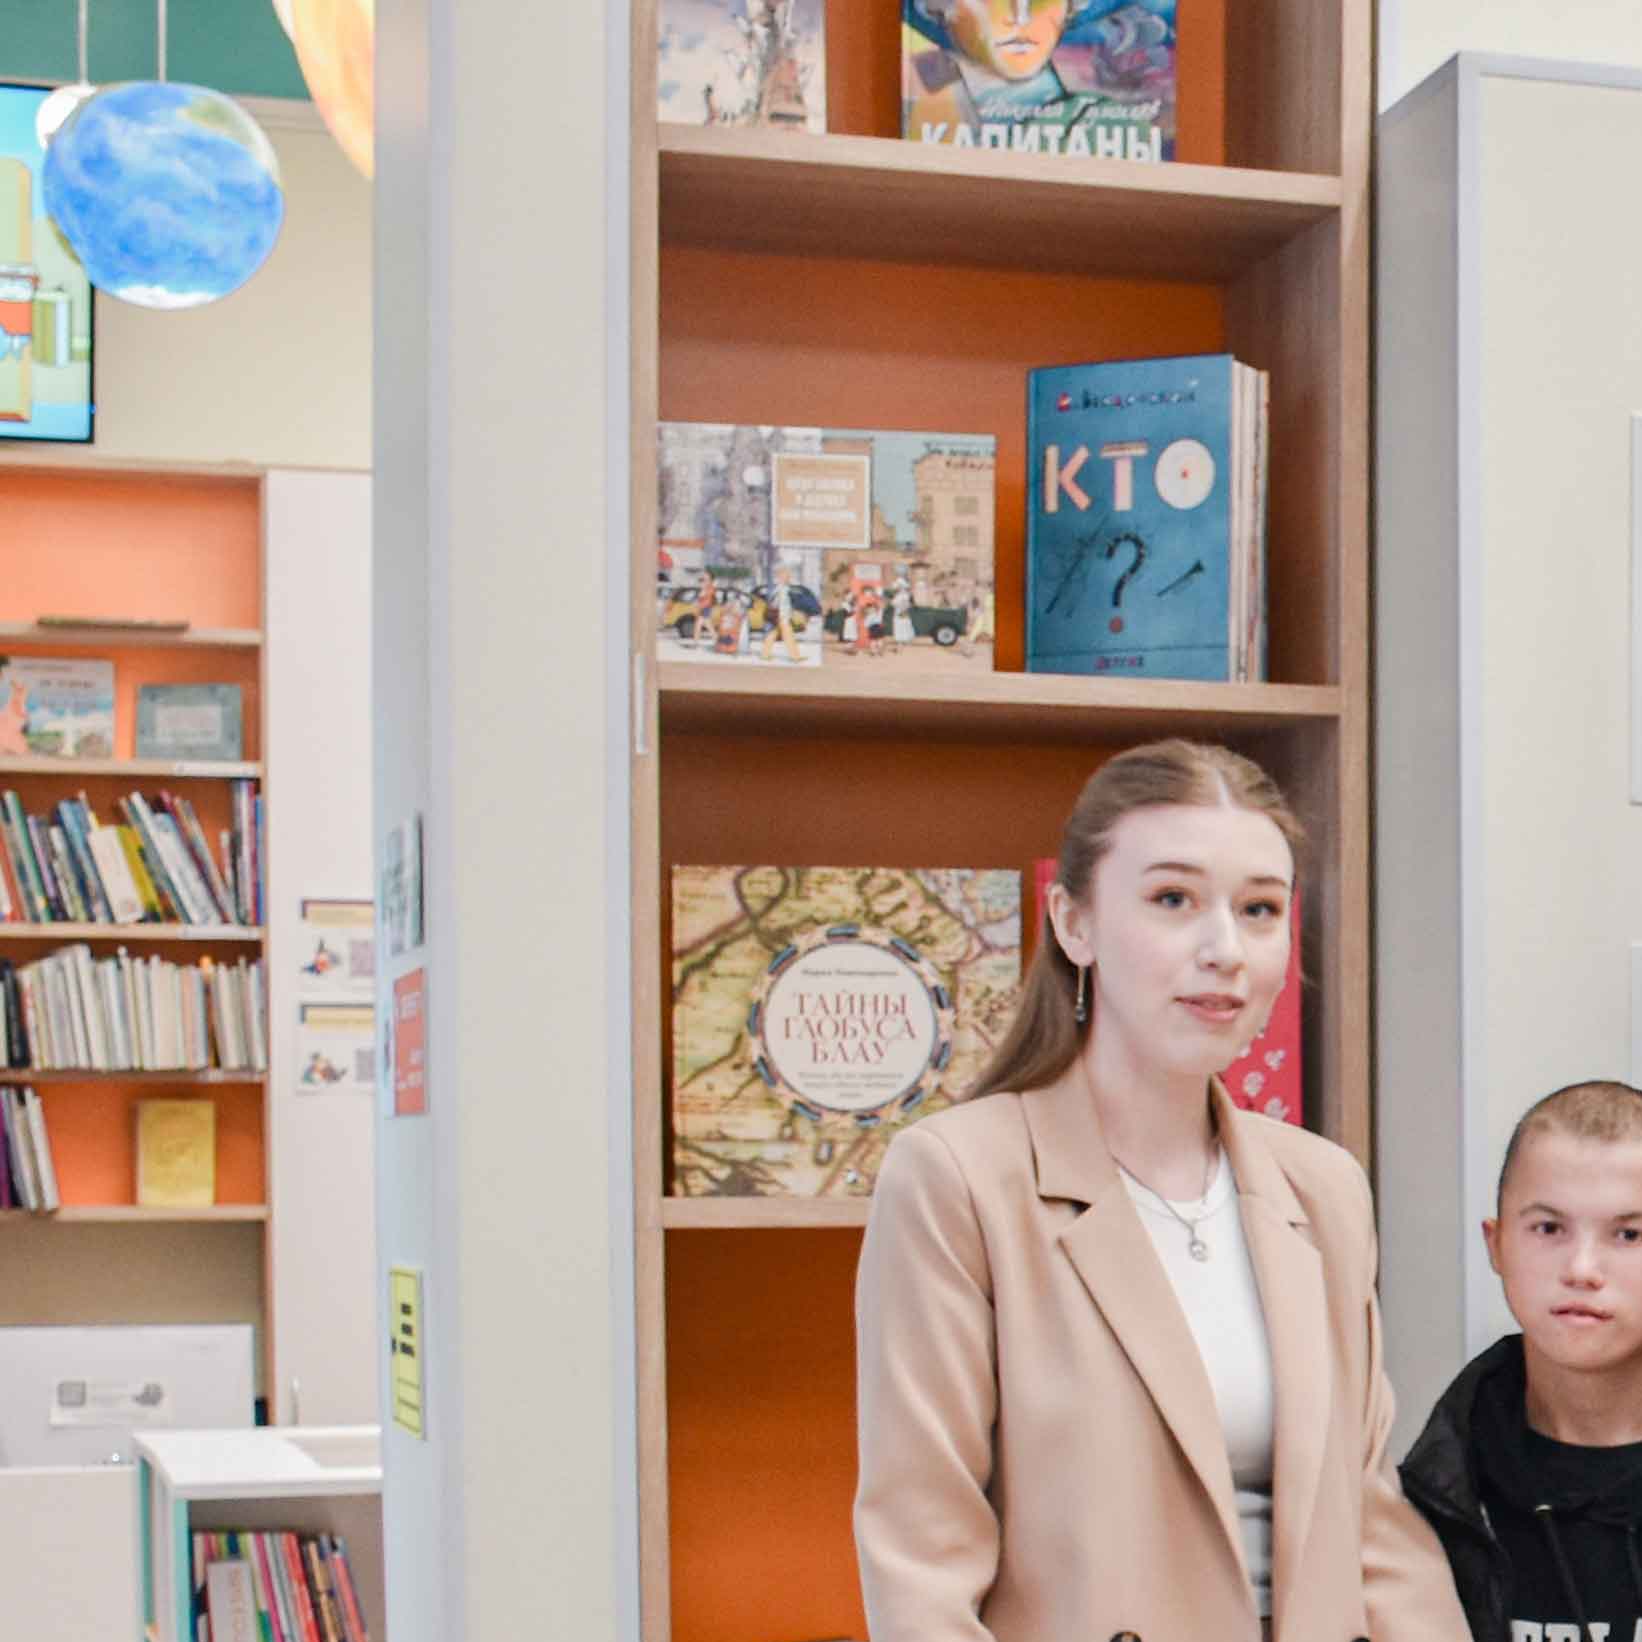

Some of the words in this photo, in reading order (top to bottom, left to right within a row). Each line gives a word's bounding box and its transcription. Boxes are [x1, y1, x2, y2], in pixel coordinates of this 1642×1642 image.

[921, 121, 1162, 162] КАПИТАНЫ
[1043, 438, 1216, 513] КТО
[793, 988, 907, 1016] ТАЙНЫ
[784, 1015, 917, 1041] ГЛОБУСА
[811, 1040, 889, 1065] БЛАУ
